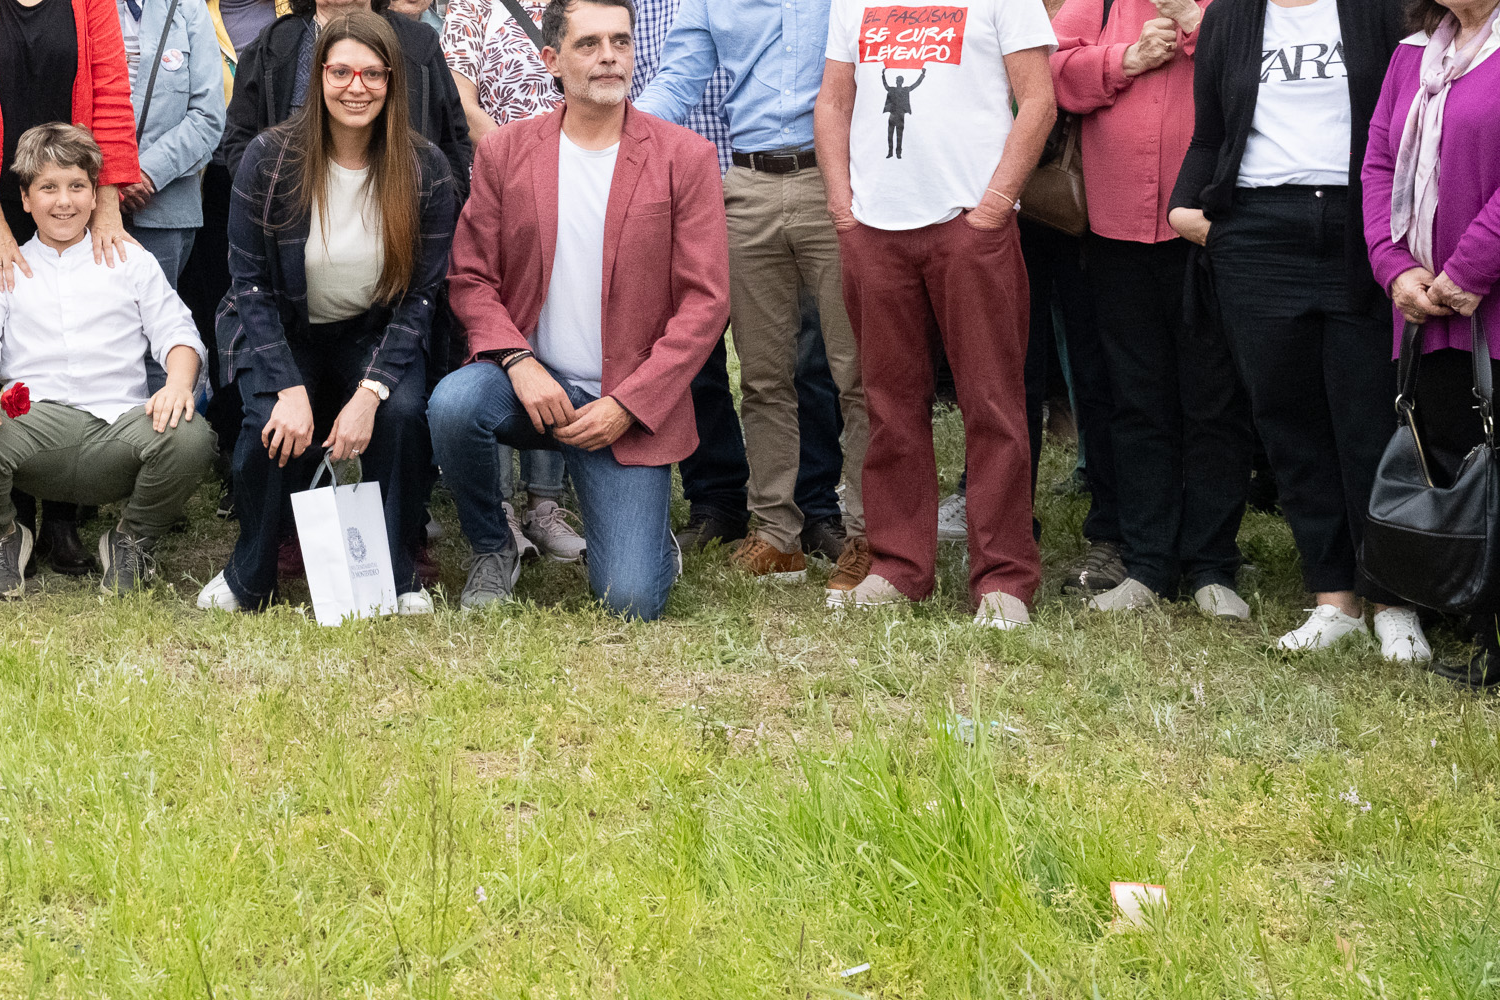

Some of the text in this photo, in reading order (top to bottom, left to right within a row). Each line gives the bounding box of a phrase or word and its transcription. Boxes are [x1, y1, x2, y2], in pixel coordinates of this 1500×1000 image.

[864, 8, 964, 26] EL FASCISMO
[865, 26, 957, 45] SE CURA
[863, 44, 951, 62] LEYENDO
